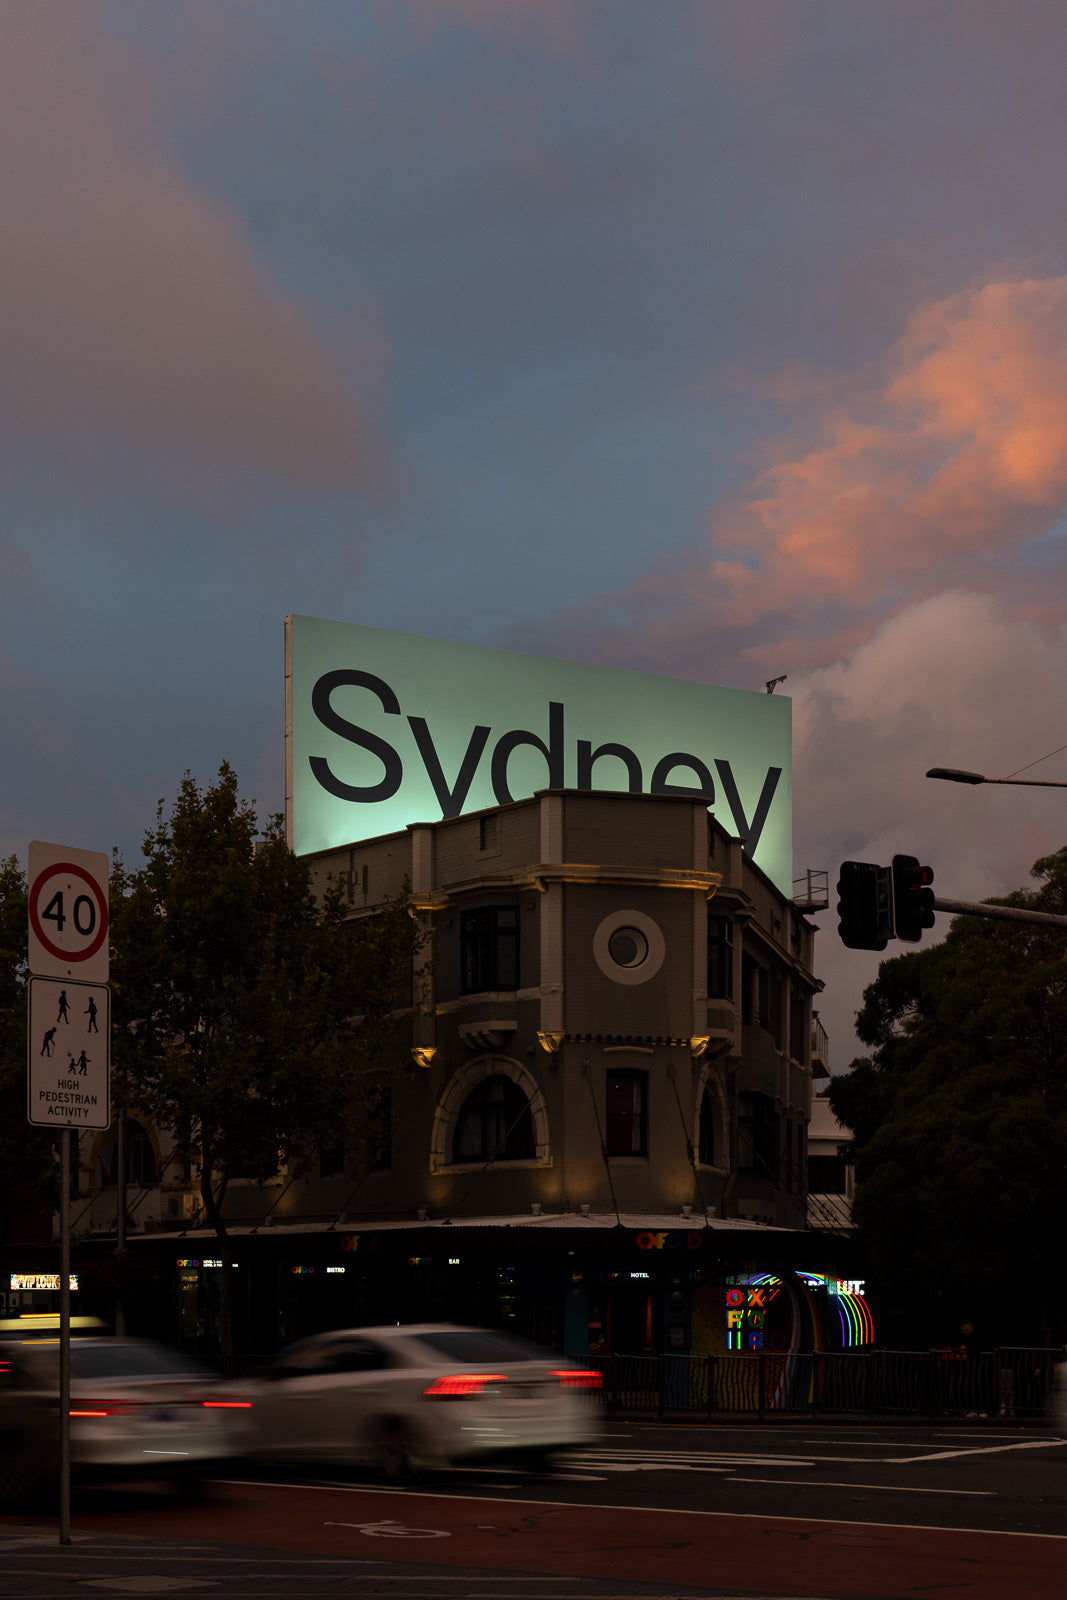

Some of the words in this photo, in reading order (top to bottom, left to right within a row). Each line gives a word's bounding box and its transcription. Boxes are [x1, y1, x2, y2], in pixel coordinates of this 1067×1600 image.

[308, 669, 783, 859] Sydney
[42, 891, 95, 935] 40
[58, 1079, 79, 1091] HIGH
[39, 1091, 97, 1105] PEDESTRIAN
[47, 1105, 89, 1118] ACTIVITY
